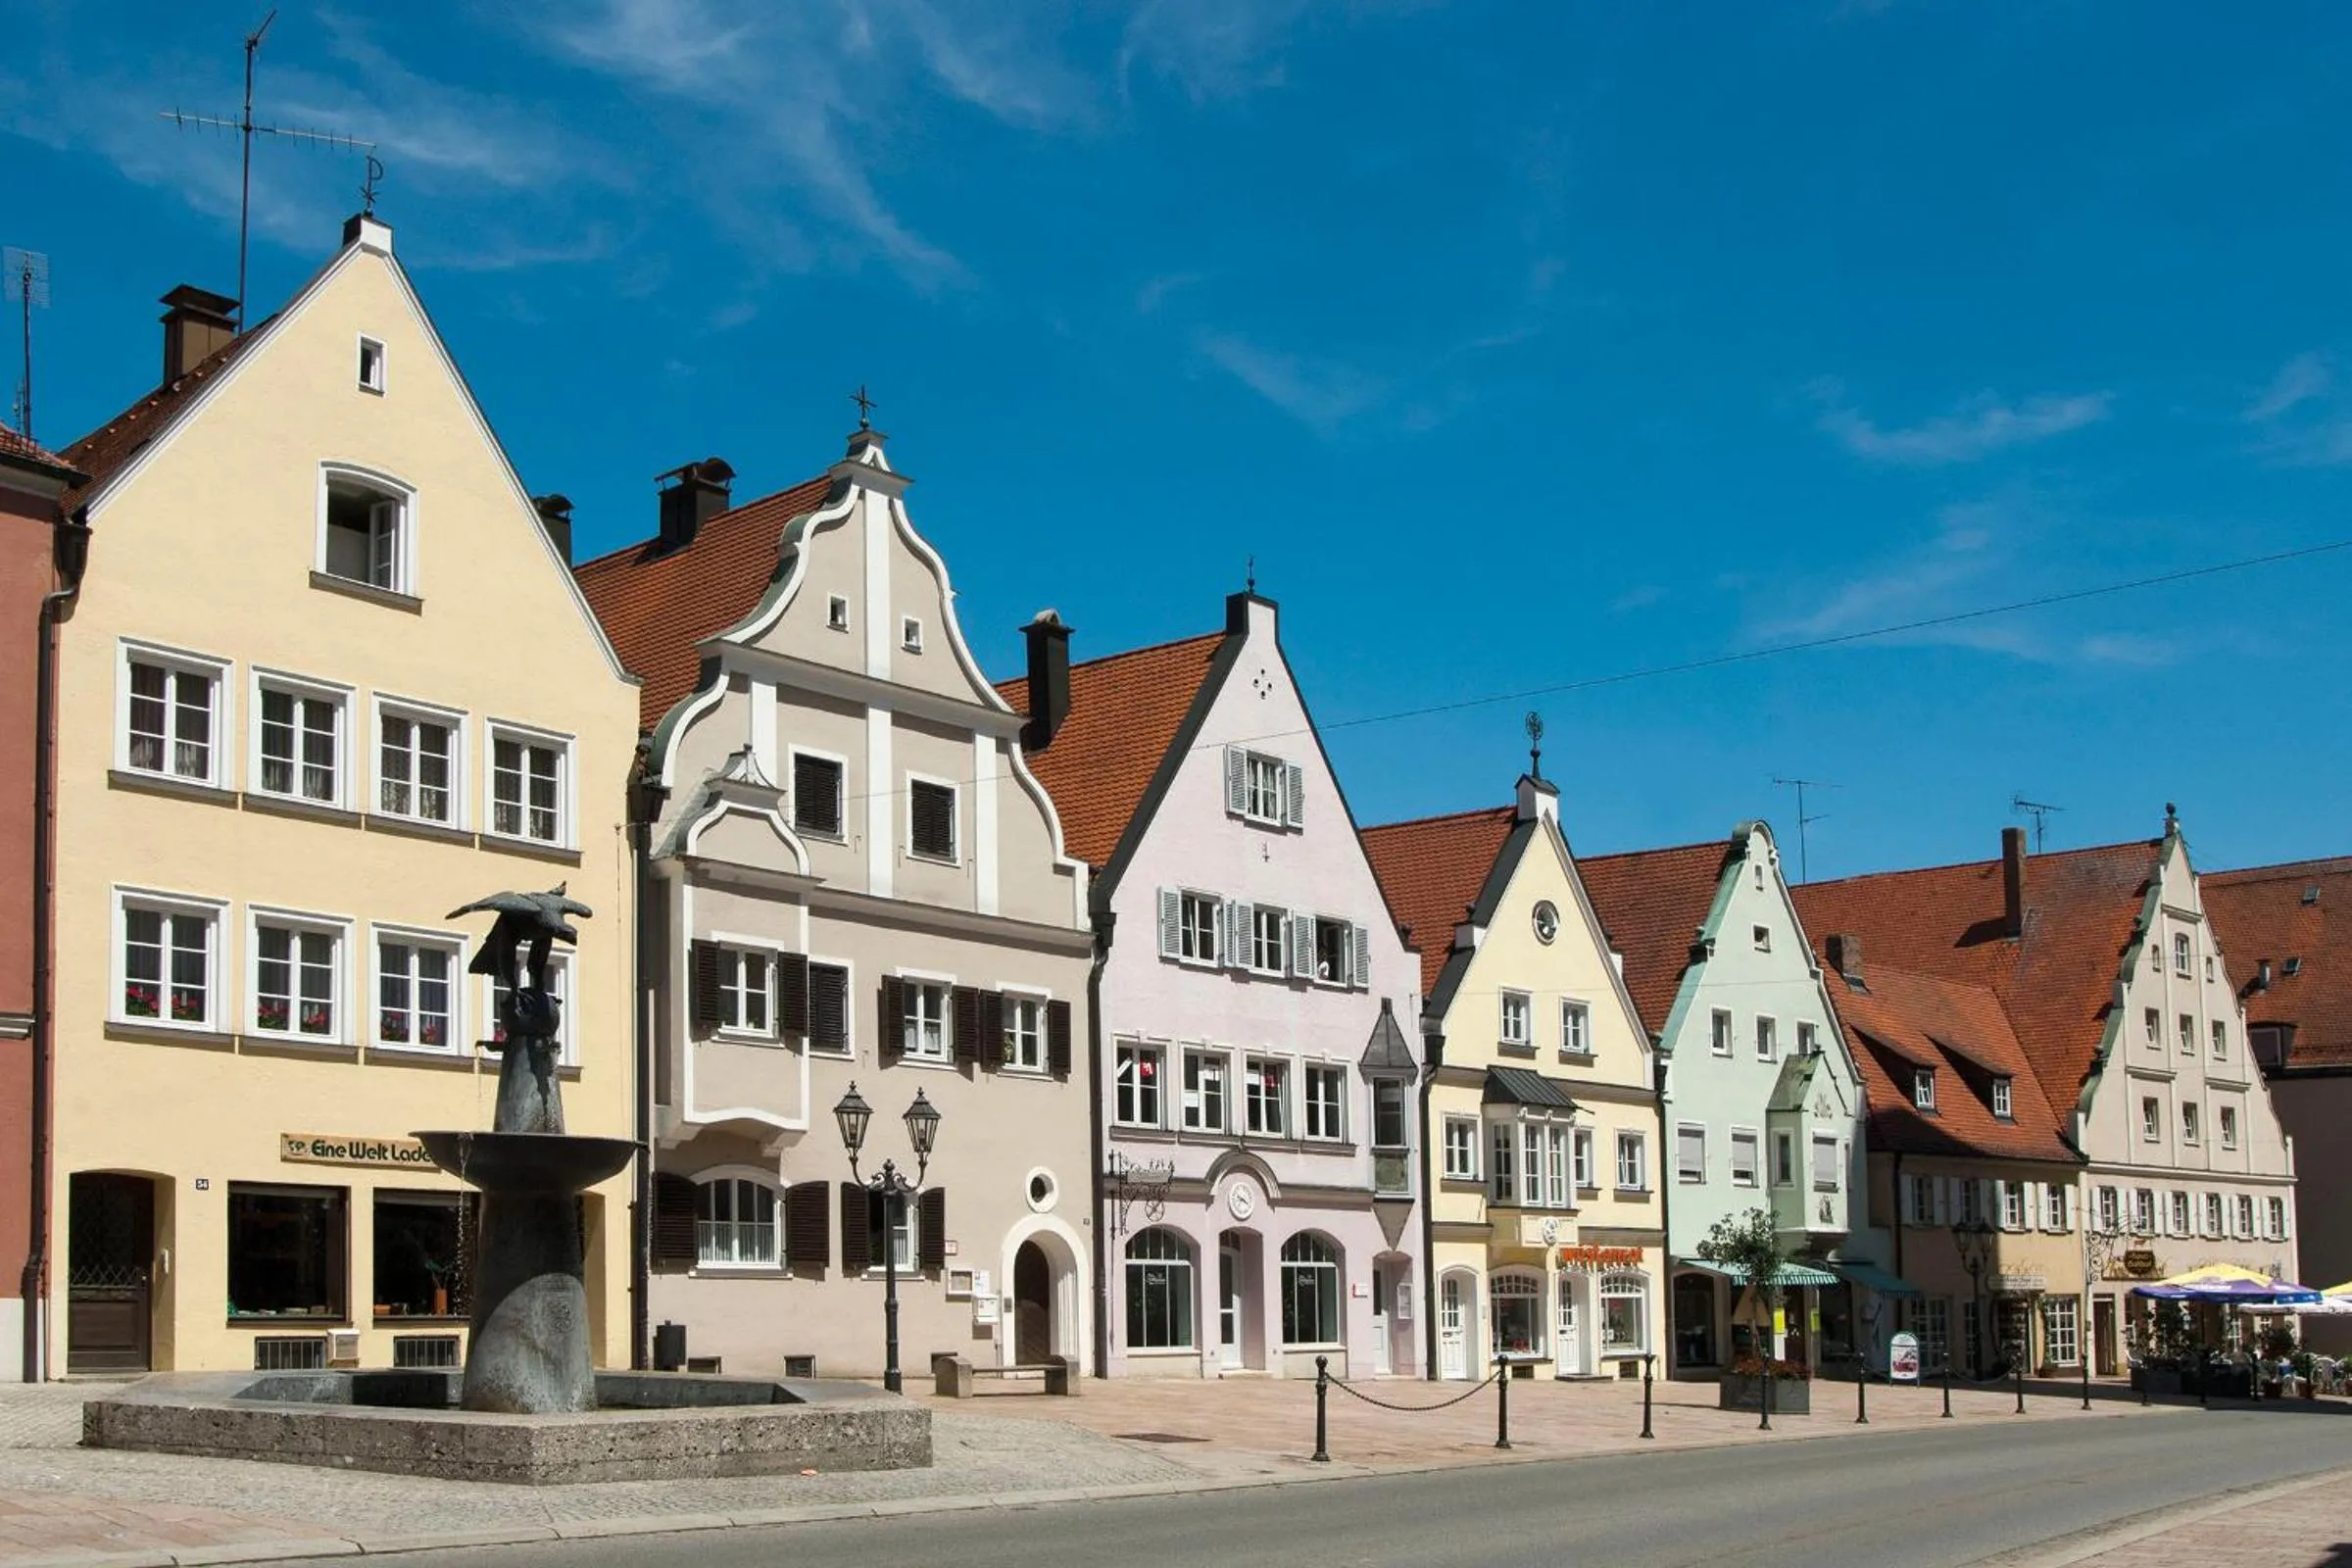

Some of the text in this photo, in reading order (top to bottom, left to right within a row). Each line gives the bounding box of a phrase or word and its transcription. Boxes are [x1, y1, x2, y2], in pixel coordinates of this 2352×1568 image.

[311, 1139, 432, 1162] Eine Welt Lade
